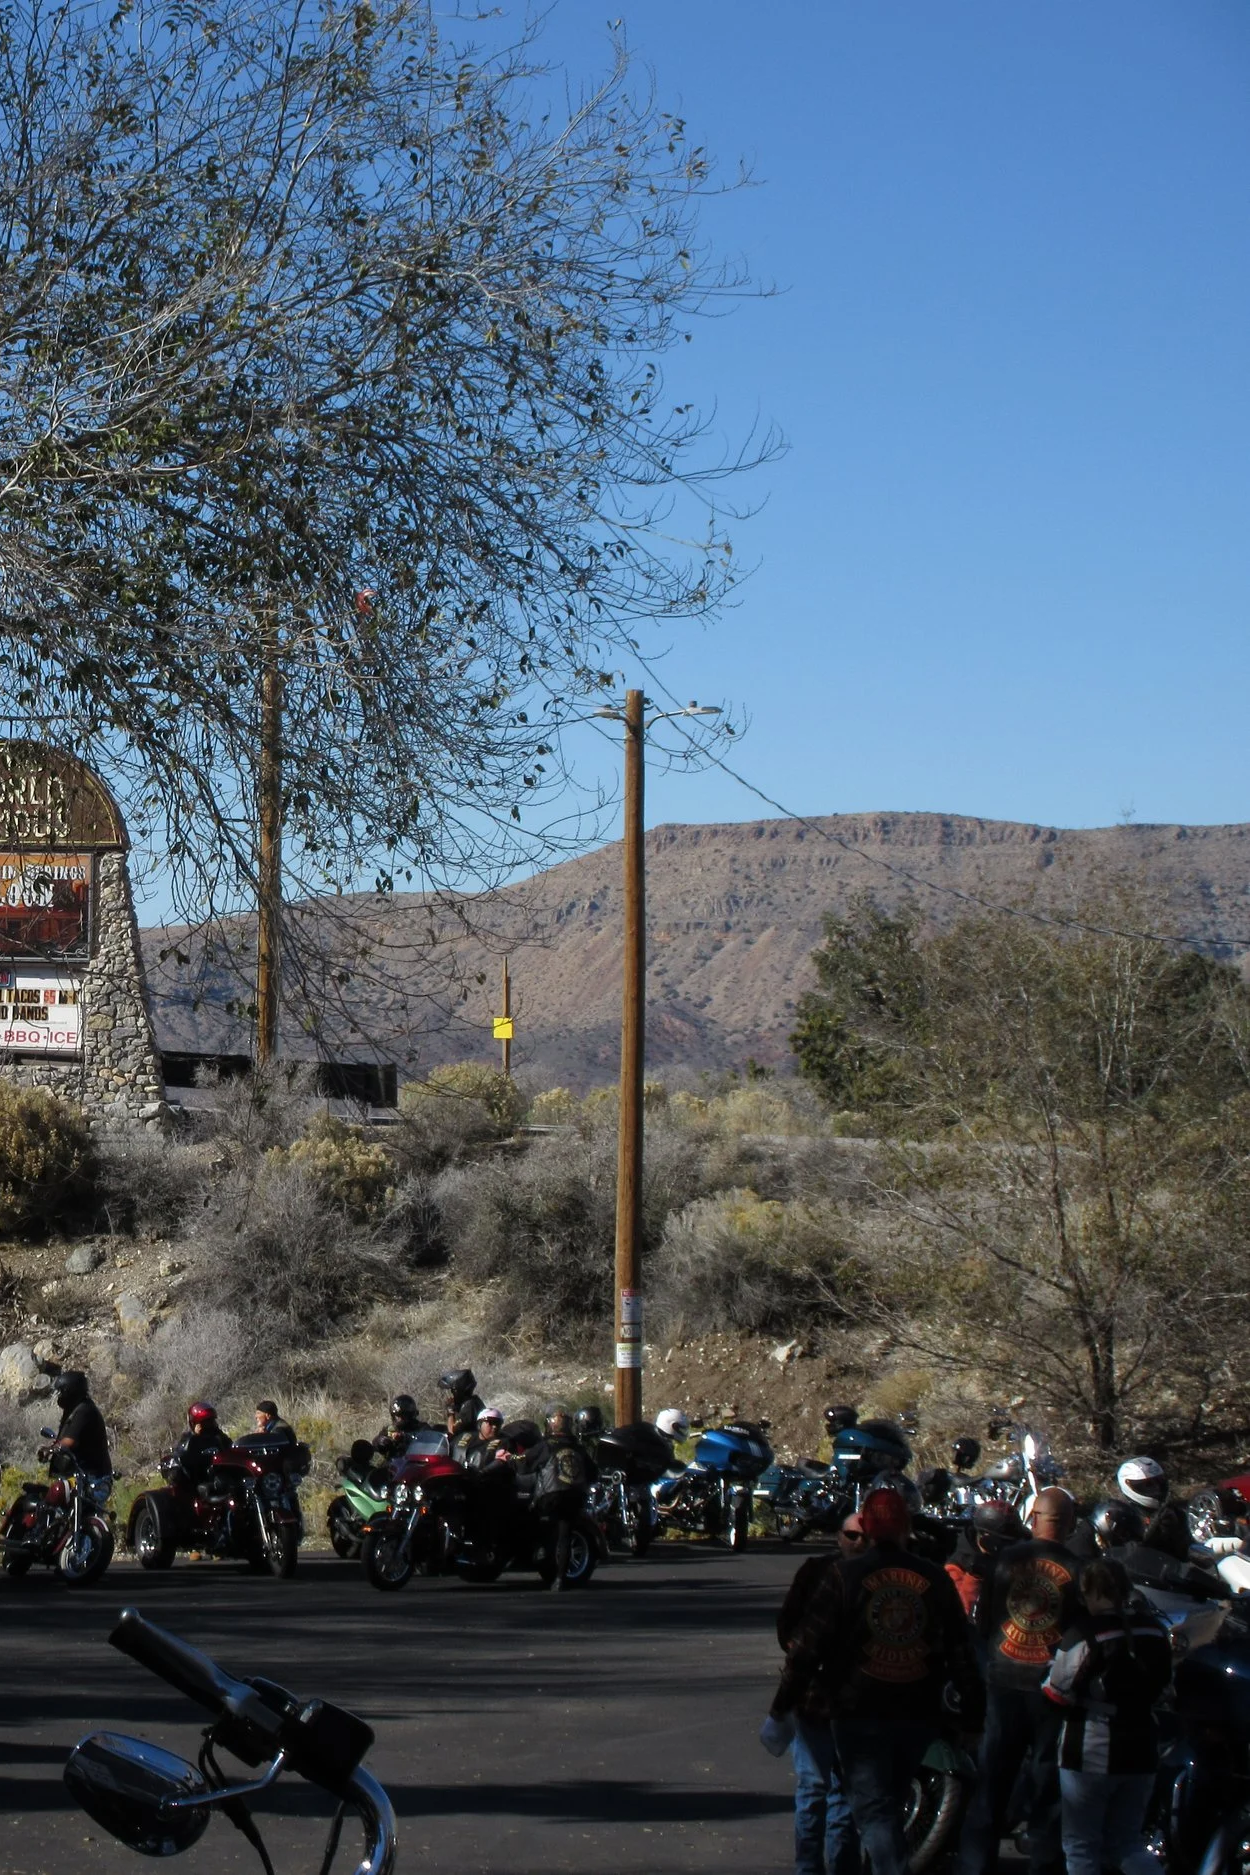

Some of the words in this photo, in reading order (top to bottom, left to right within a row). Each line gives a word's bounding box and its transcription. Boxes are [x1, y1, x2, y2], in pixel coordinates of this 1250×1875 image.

[6, 989, 41, 1004] TACOS
[13, 1006, 49, 1021] BANDS
[4, 1030, 41, 1044] BBQ
[50, 1031, 77, 1044] ICE
[866, 1570, 928, 1592] MARINE
[1006, 1624, 1054, 1646] RIDERS
